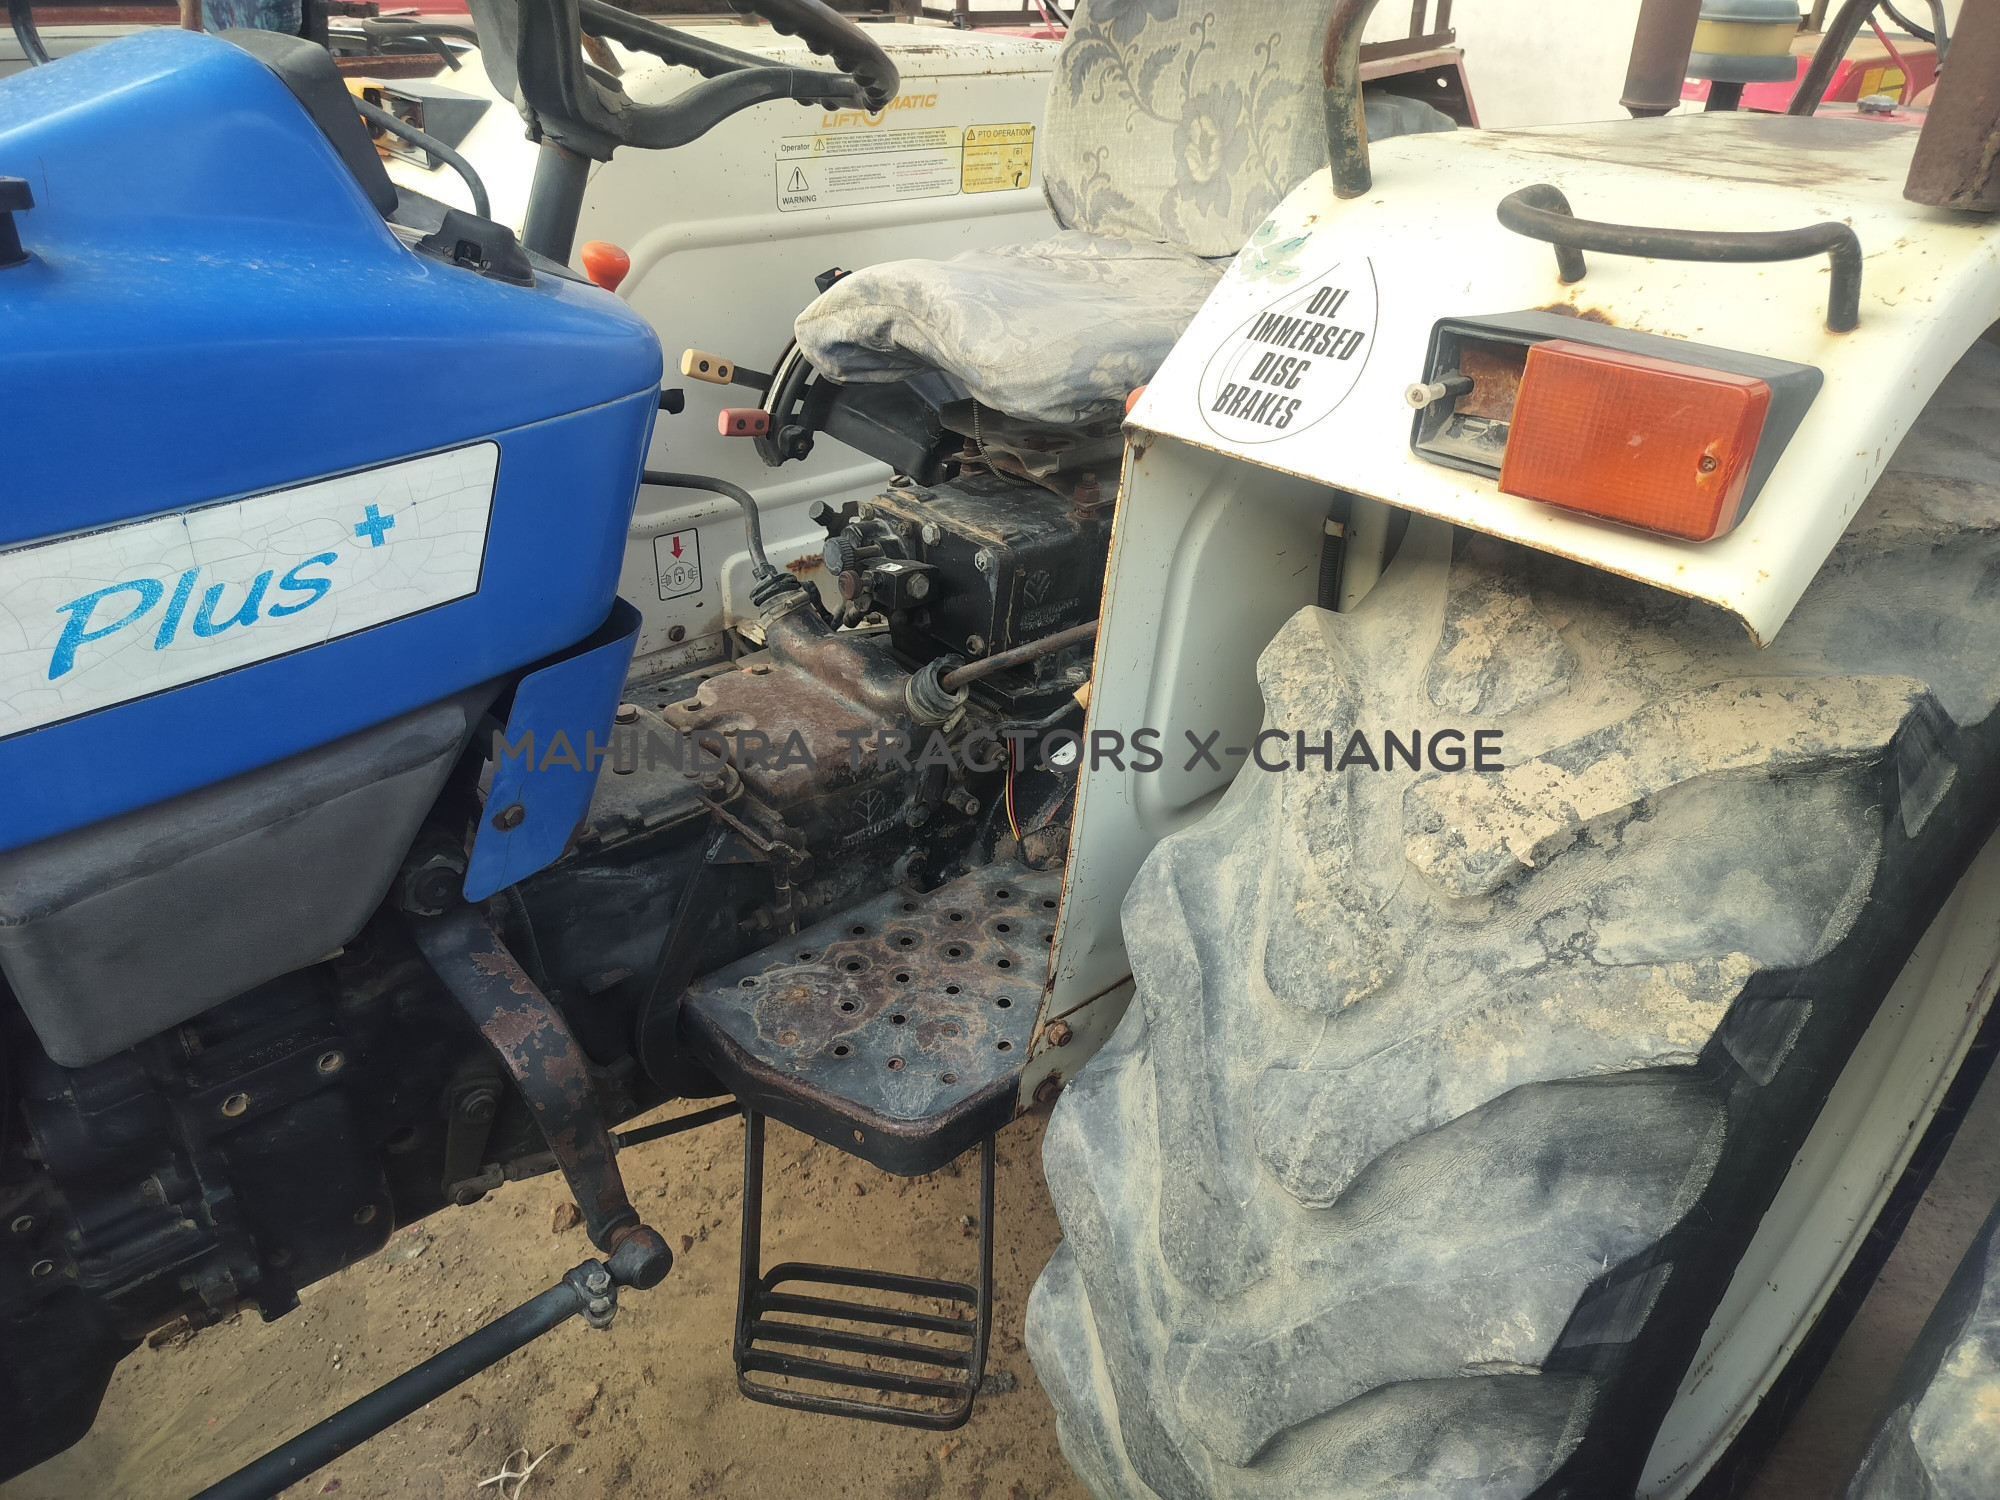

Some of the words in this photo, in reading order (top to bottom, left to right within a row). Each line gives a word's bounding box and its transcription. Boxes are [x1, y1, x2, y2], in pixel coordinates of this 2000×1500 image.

[780, 143, 810, 154] Operator
[978, 130, 992, 138] PTO
[993, 128, 1031, 138] OPERATION
[782, 194, 817, 205] WARNING
[1305, 286, 1350, 319] OIL
[1246, 311, 1366, 361] IMMERSED
[1248, 351, 1312, 390] DISC
[1211, 382, 1303, 430] BRAKES
